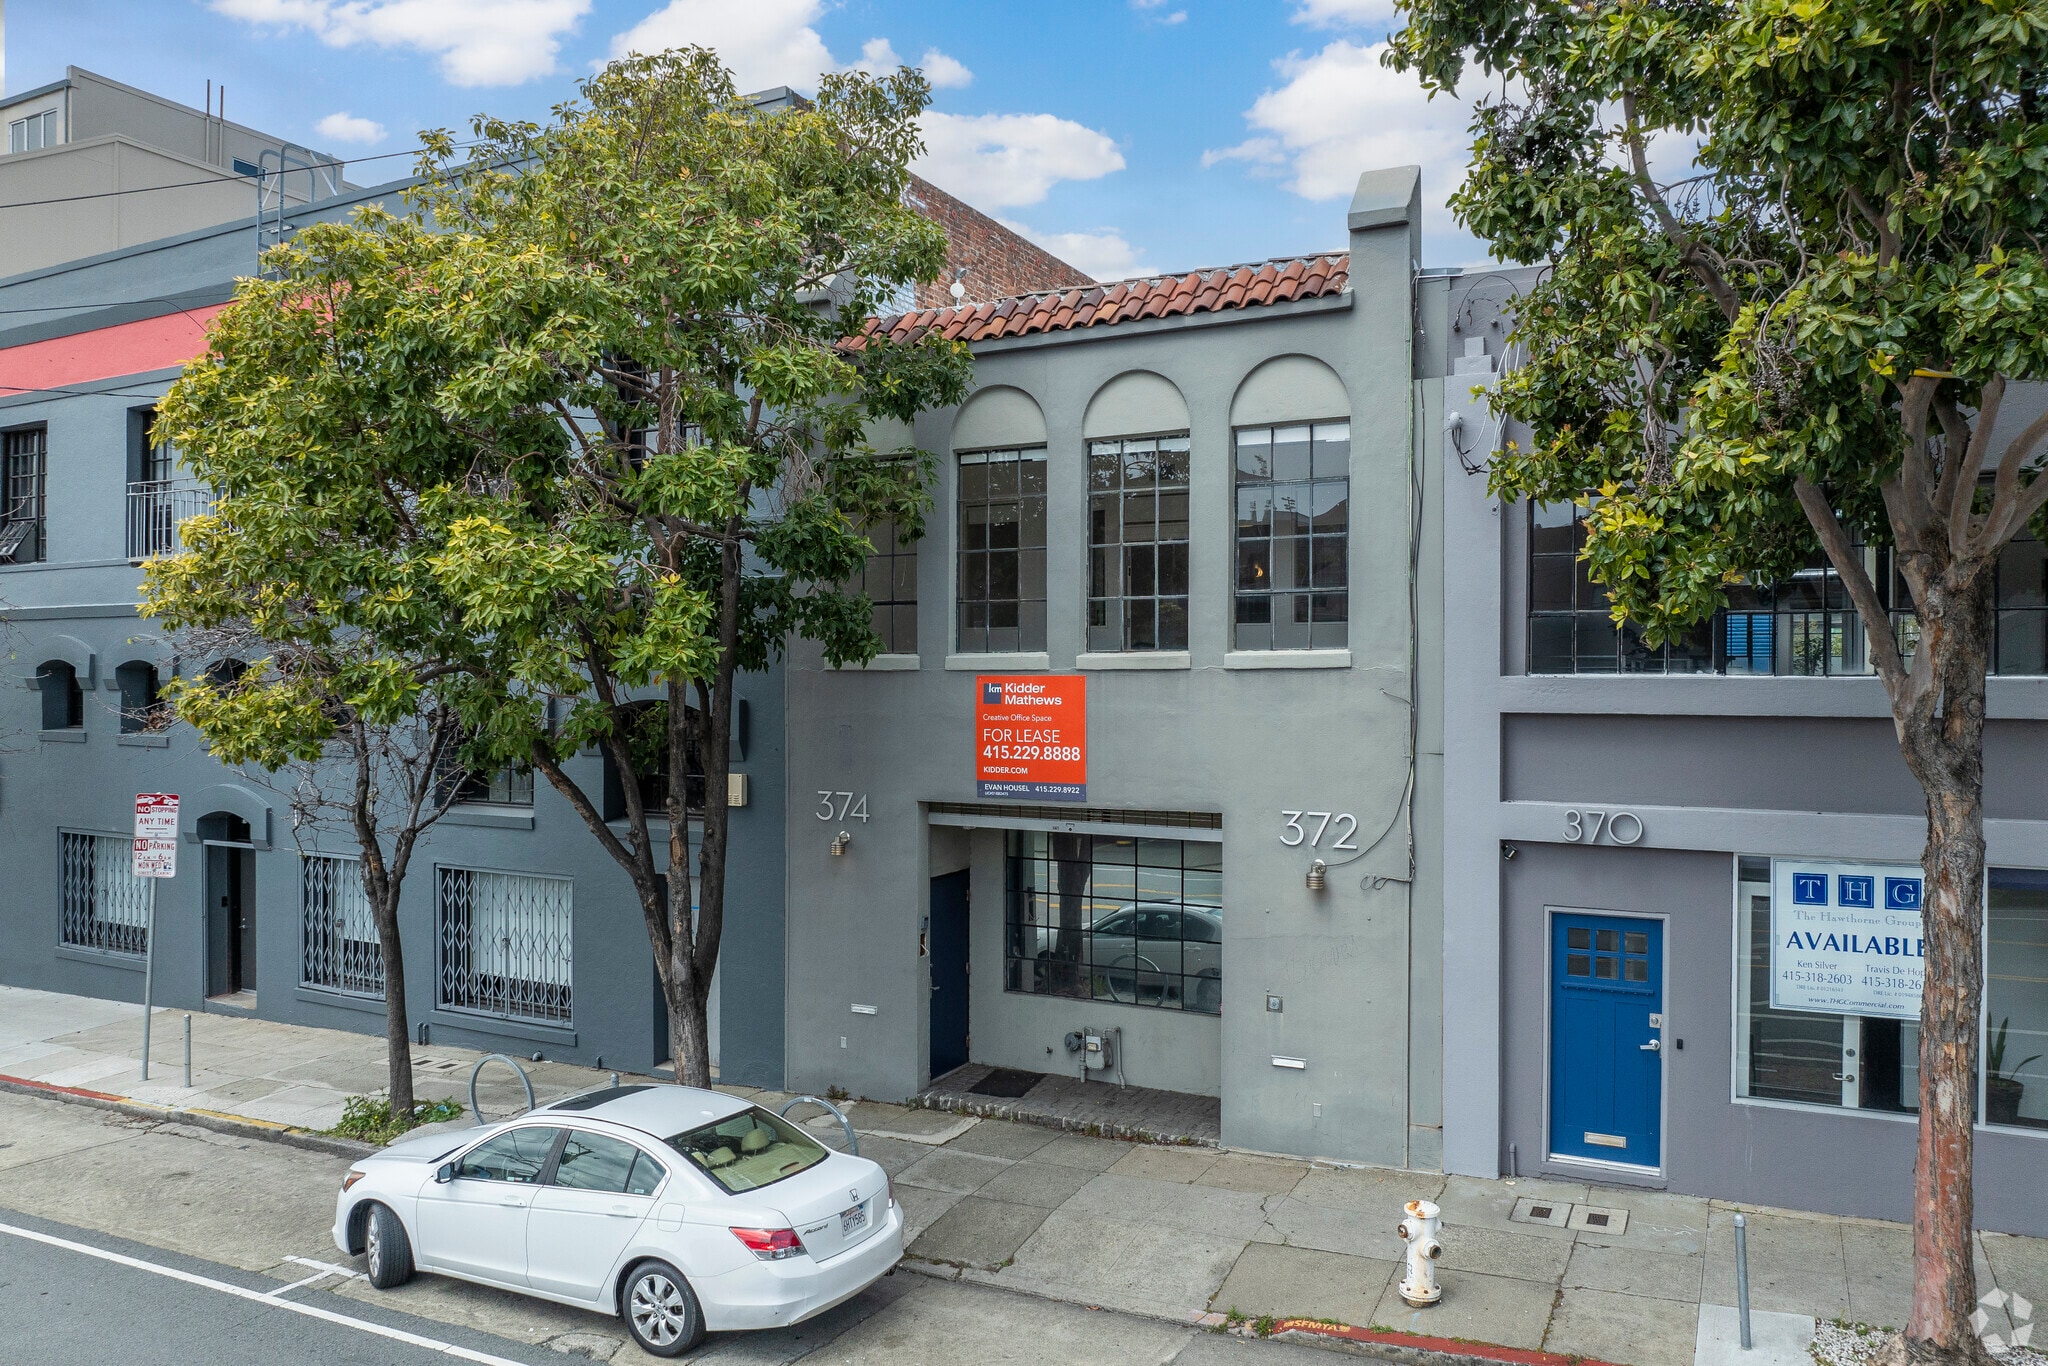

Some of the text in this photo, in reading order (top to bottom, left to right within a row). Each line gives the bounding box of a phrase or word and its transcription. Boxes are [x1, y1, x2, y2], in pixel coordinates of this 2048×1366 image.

[1005, 683, 1046, 693] Kidder
[1005, 695, 1062, 705] Mathews
[982, 713, 1052, 723] Creative Office Space
[983, 729, 1060, 743] FOR LEASE
[983, 745, 1080, 761] 415.229.8888
[983, 766, 1028, 774] KIDDER.COM
[1003, 784, 1030, 792] HOUSEL
[1035, 785, 1080, 794] 415.229.8922
[815, 790, 870, 823] 374
[138, 817, 175, 826] ANY TIME
[1562, 809, 1643, 844] 370
[1279, 810, 1357, 850] 372
[135, 839, 175, 851] NO PARKING
[1793, 909, 1922, 928] The Hawthorne Group
[1786, 931, 1925, 957] AVAILABLE
[1797, 959, 1838, 971] Ken Silver
[1865, 964, 1925, 979] Travis De Hop
[1782, 970, 1853, 985] 415-318-2603
[1861, 976, 1922, 990] 415-318-26
[1808, 997, 1905, 1010] www.THGCommercial.com
[803, 1223, 829, 1236] Accord
[1293, 1319, 1337, 1331] SFMTA
